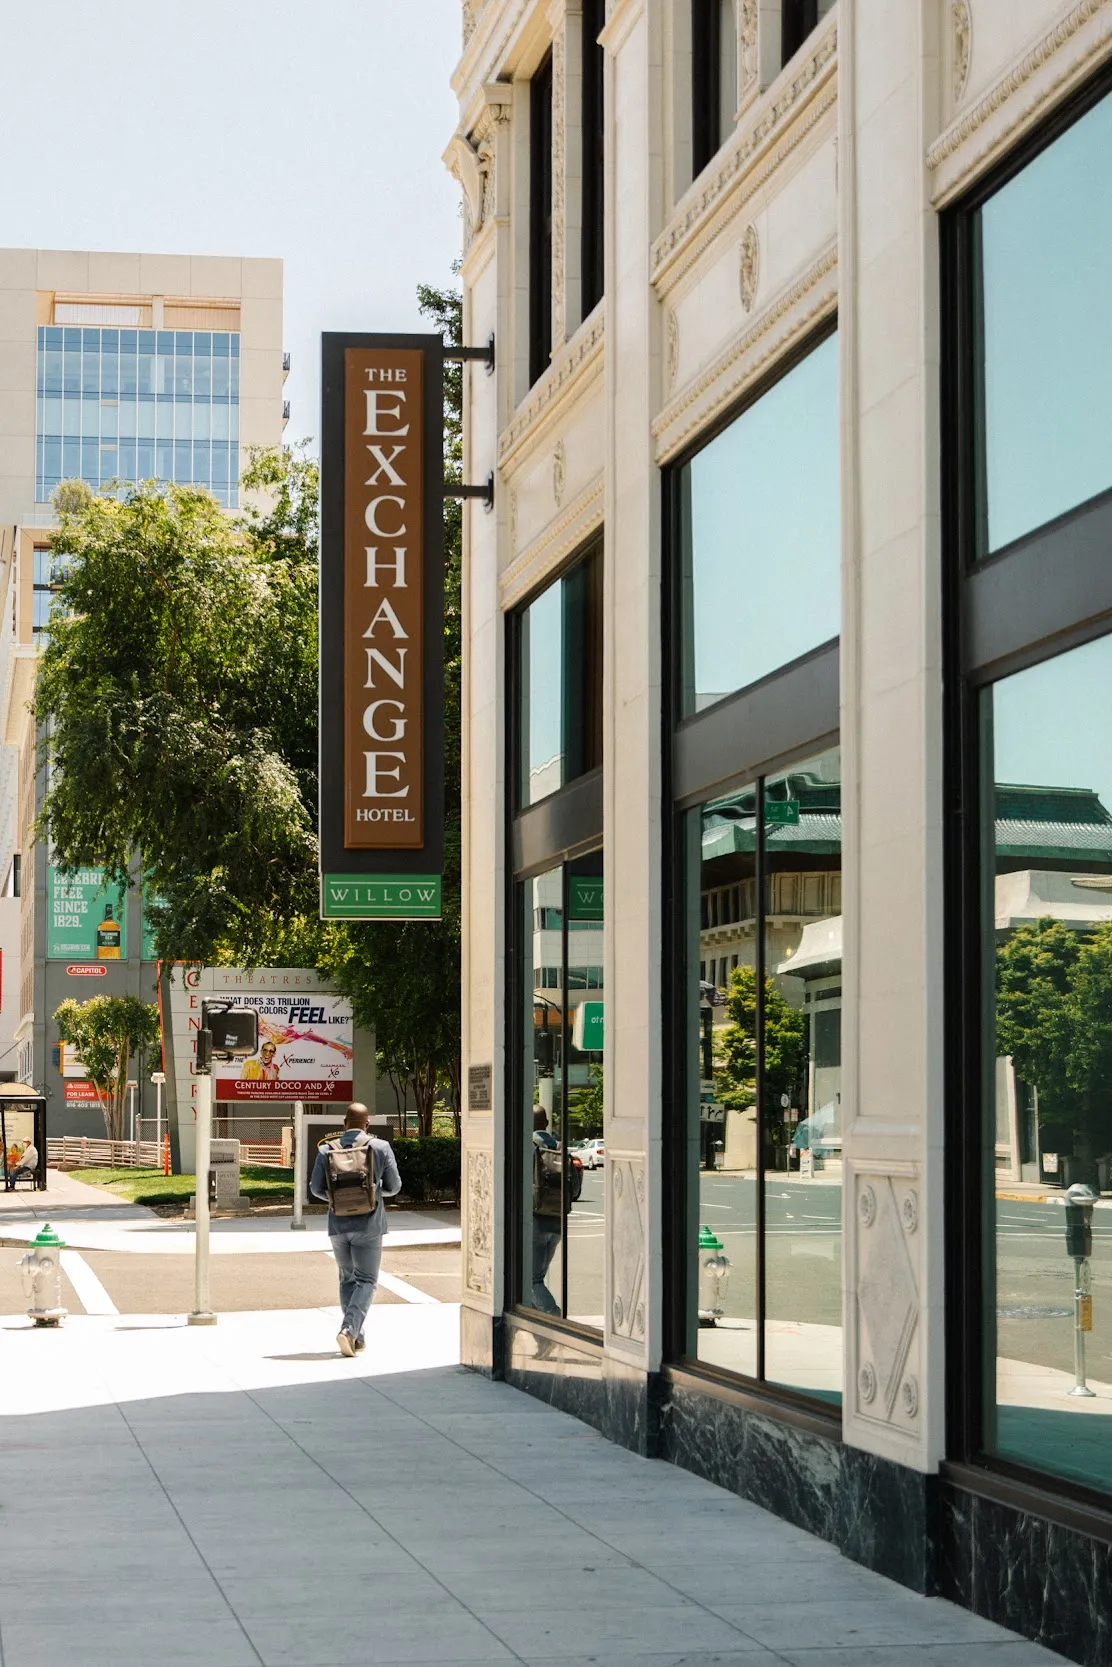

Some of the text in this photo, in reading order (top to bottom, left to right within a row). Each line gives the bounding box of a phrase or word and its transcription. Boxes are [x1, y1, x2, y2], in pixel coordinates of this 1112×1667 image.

[365, 368, 407, 382] THE
[362, 389, 410, 798] EXCHANGE
[356, 809, 415, 822] HOTEL
[53, 886, 83, 899] FREE
[330, 888, 436, 902] WILLOW
[53, 901, 88, 914] SINCE
[53, 915, 83, 928] 1829.
[223, 975, 312, 984] THEATRES
[244, 997, 264, 1006] DOES
[265, 997, 276, 1006] 35
[277, 998, 310, 1006] TRILLION
[259, 1007, 349, 1025] COLORS FEEL LIKE?
[234, 1081, 272, 1090] CENTURY
[274, 1081, 301, 1090] DOCO
[305, 1082, 322, 1090] AND
